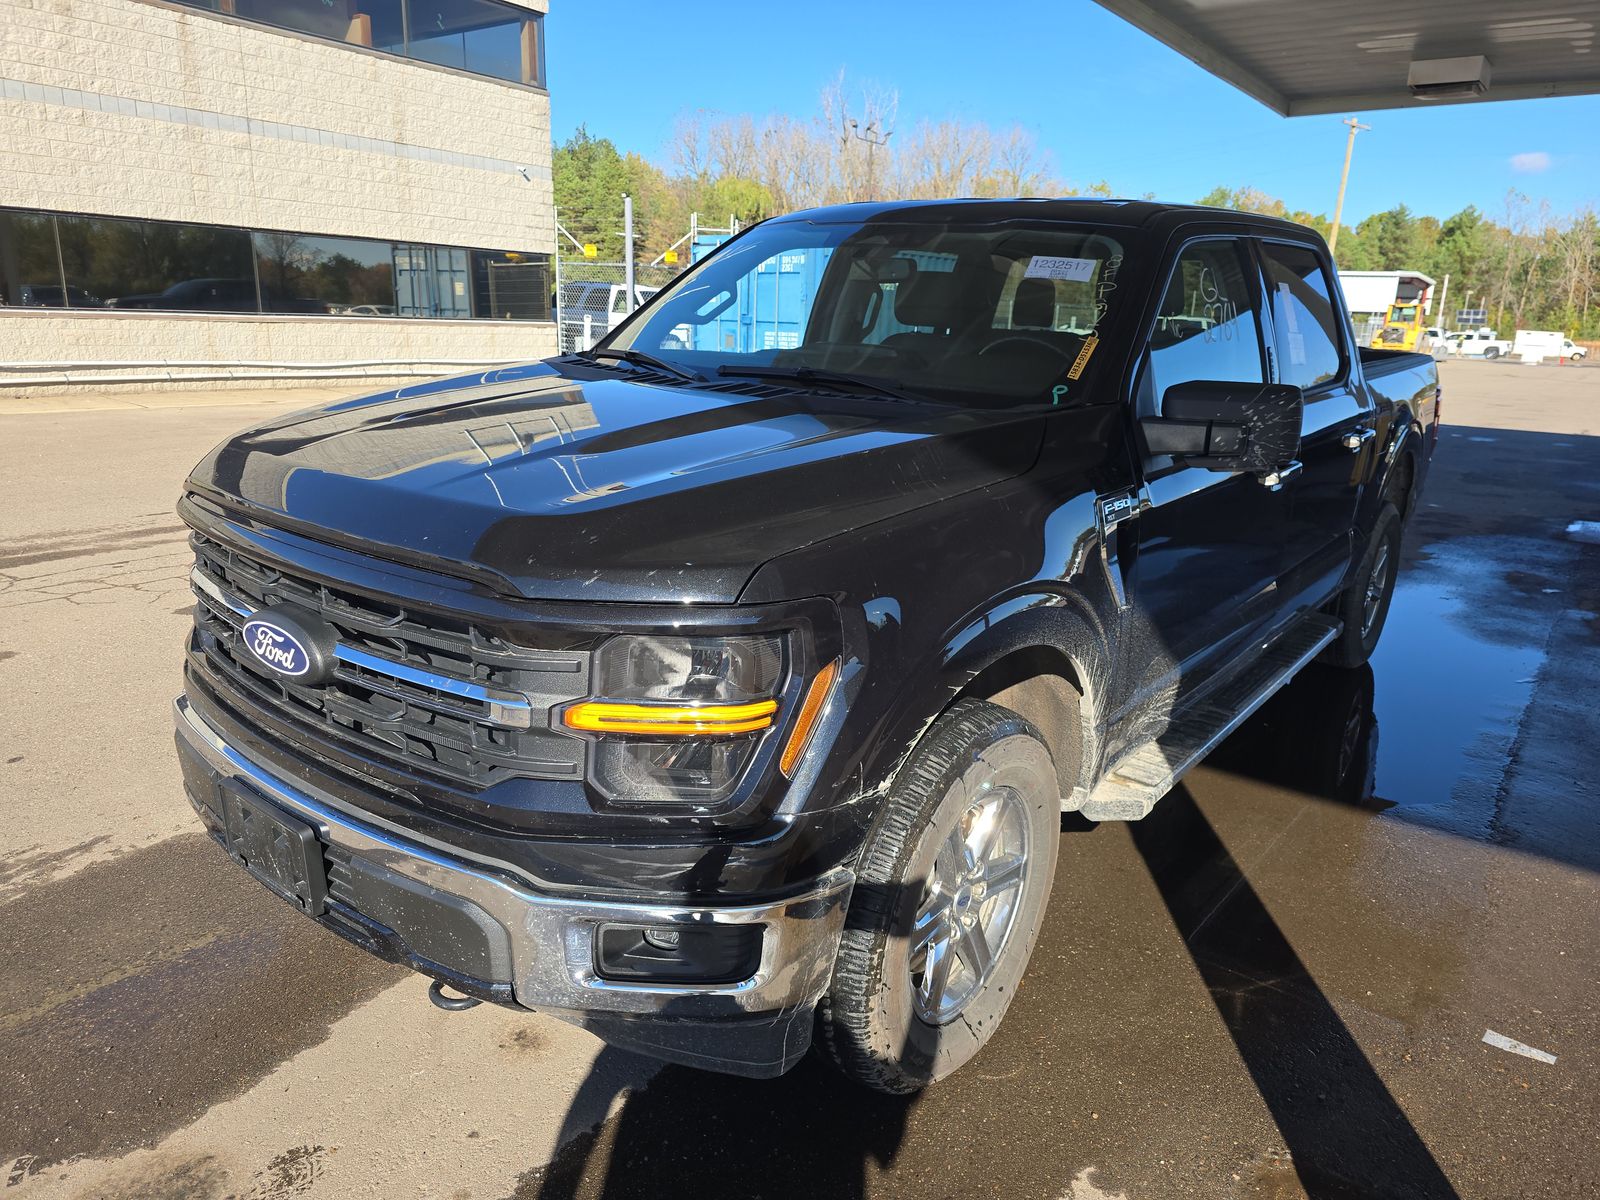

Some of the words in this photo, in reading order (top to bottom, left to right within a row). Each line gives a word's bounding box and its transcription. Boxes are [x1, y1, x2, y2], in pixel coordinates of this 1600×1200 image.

[1033, 259, 1089, 271] 1232517
[1105, 499, 1130, 515] F-150
[254, 626, 295, 670] Ford
